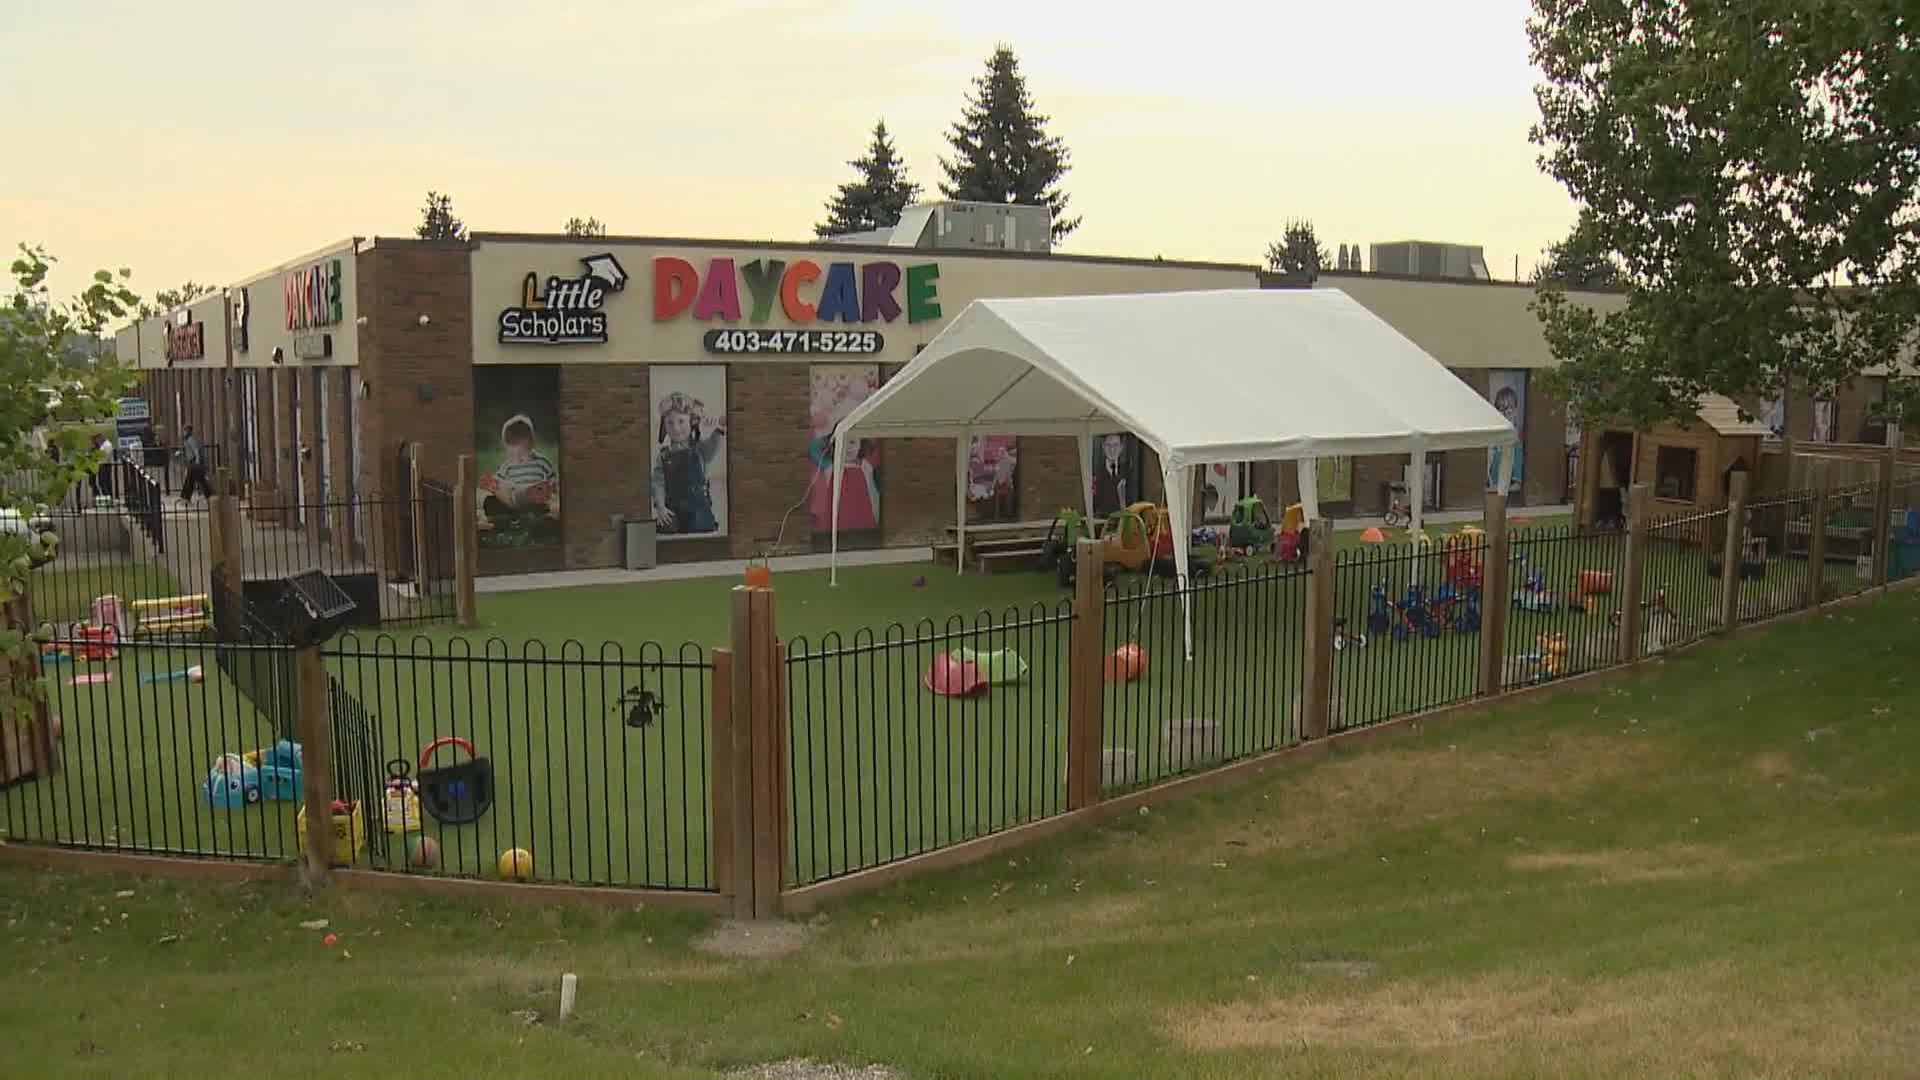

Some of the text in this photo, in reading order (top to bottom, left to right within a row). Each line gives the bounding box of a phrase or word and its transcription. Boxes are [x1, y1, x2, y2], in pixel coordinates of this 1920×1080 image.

[524, 271, 603, 309] Little
[653, 256, 942, 324] DAYCARE
[502, 311, 604, 337] Scholars
[714, 330, 877, 353] 403-471-5225
